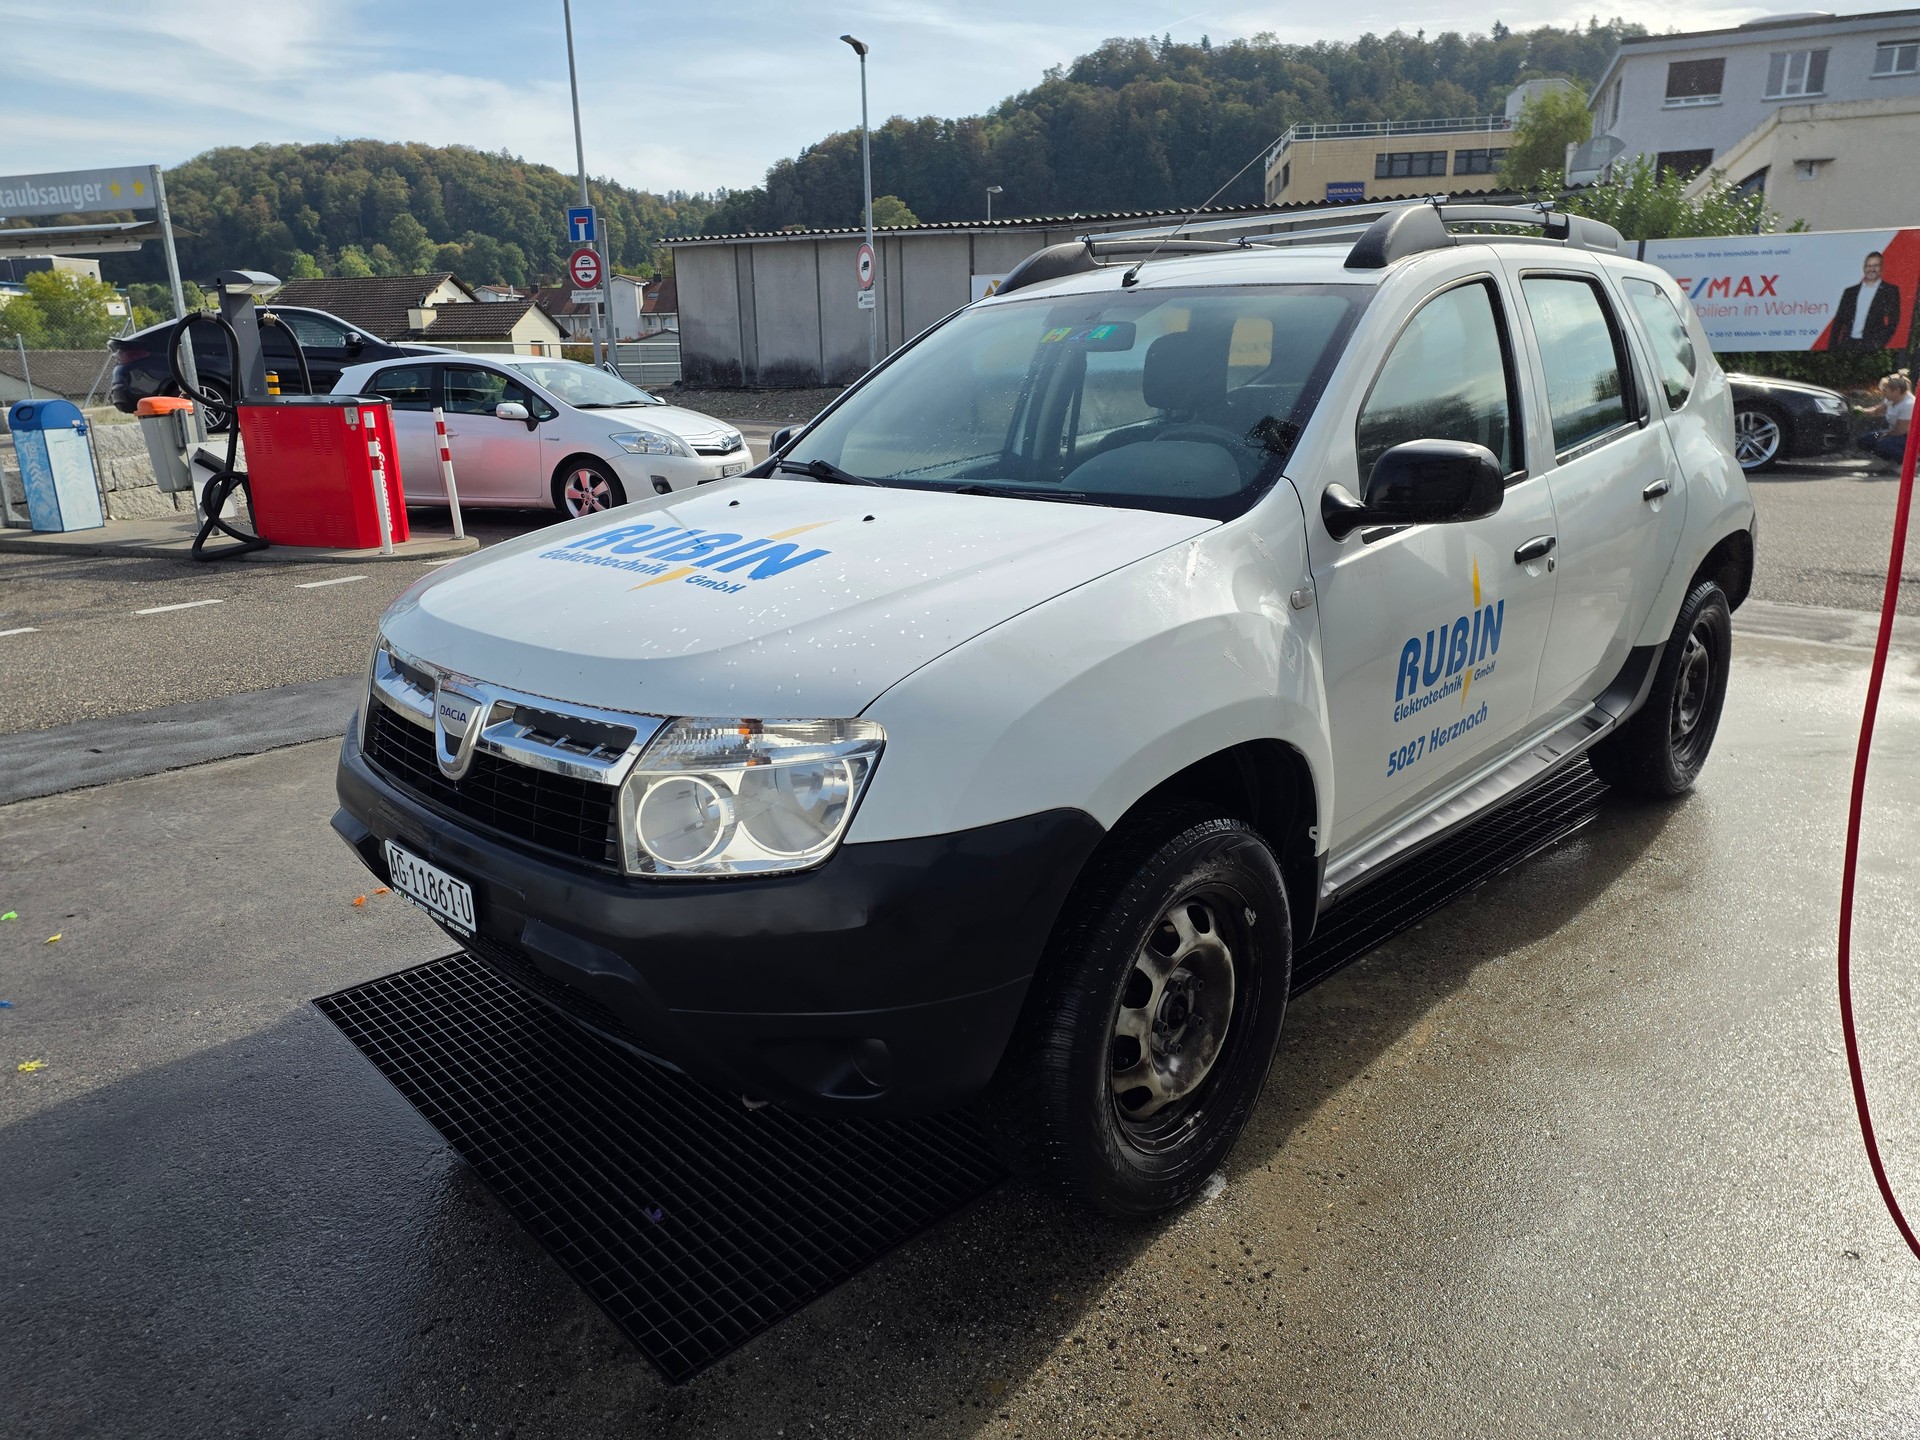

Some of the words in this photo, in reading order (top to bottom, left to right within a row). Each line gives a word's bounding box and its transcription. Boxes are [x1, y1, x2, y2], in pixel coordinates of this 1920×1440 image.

[0, 181, 102, 210] taubsauger
[1676, 274, 1780, 299] E/MAX
[1695, 302, 1738, 318] bilien
[1743, 302, 1758, 317] in
[1764, 300, 1830, 317] Wohlen
[538, 549, 669, 576] Elektrotechnik
[685, 574, 747, 594] GmbH
[562, 524, 832, 580] RUBIN
[1394, 598, 1505, 703] RUBIN
[440, 704, 467, 723] DACIA
[1393, 675, 1463, 723] Elektrotechnik
[1473, 660, 1496, 681] GmbH
[1386, 735, 1426, 778] 5027
[1428, 701, 1488, 754] Herznach
